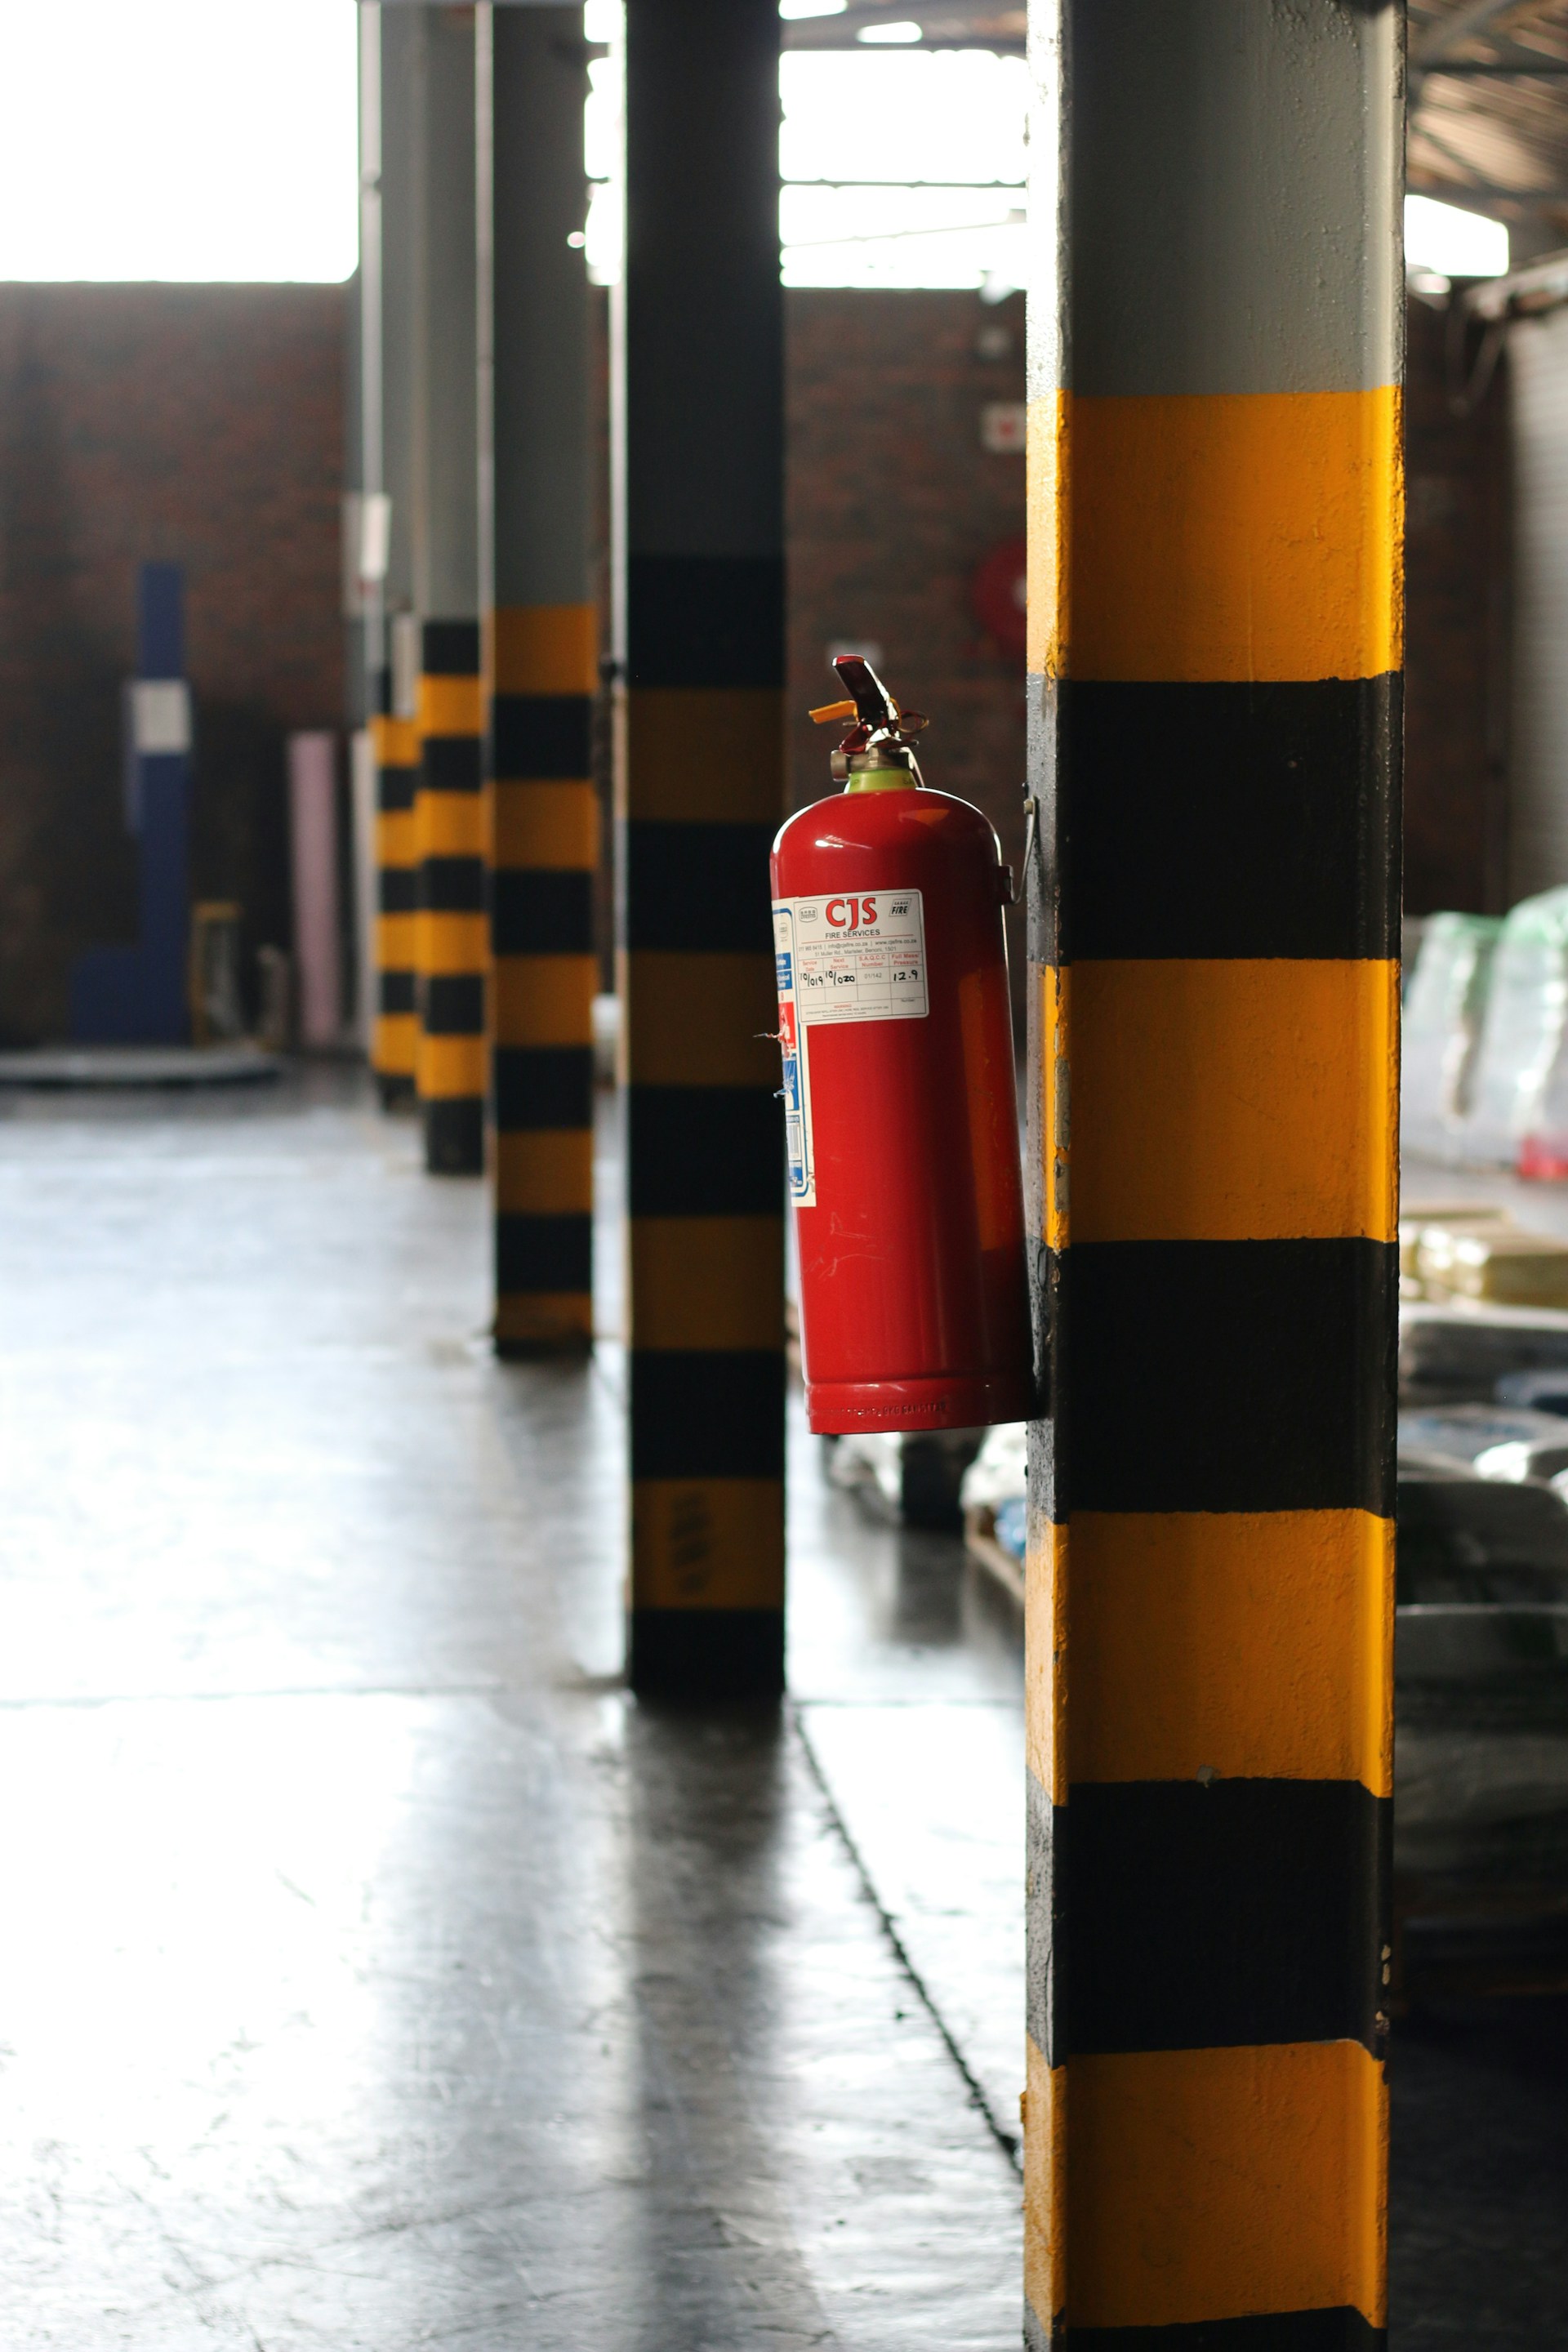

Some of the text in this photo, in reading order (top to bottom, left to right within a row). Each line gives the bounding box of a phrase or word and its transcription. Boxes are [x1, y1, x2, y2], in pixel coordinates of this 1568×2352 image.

[826, 898, 877, 931] CJS
[891, 906, 908, 915] FIRE
[842, 929, 880, 938] SERVICES
[893, 969, 918, 982] 12.9
